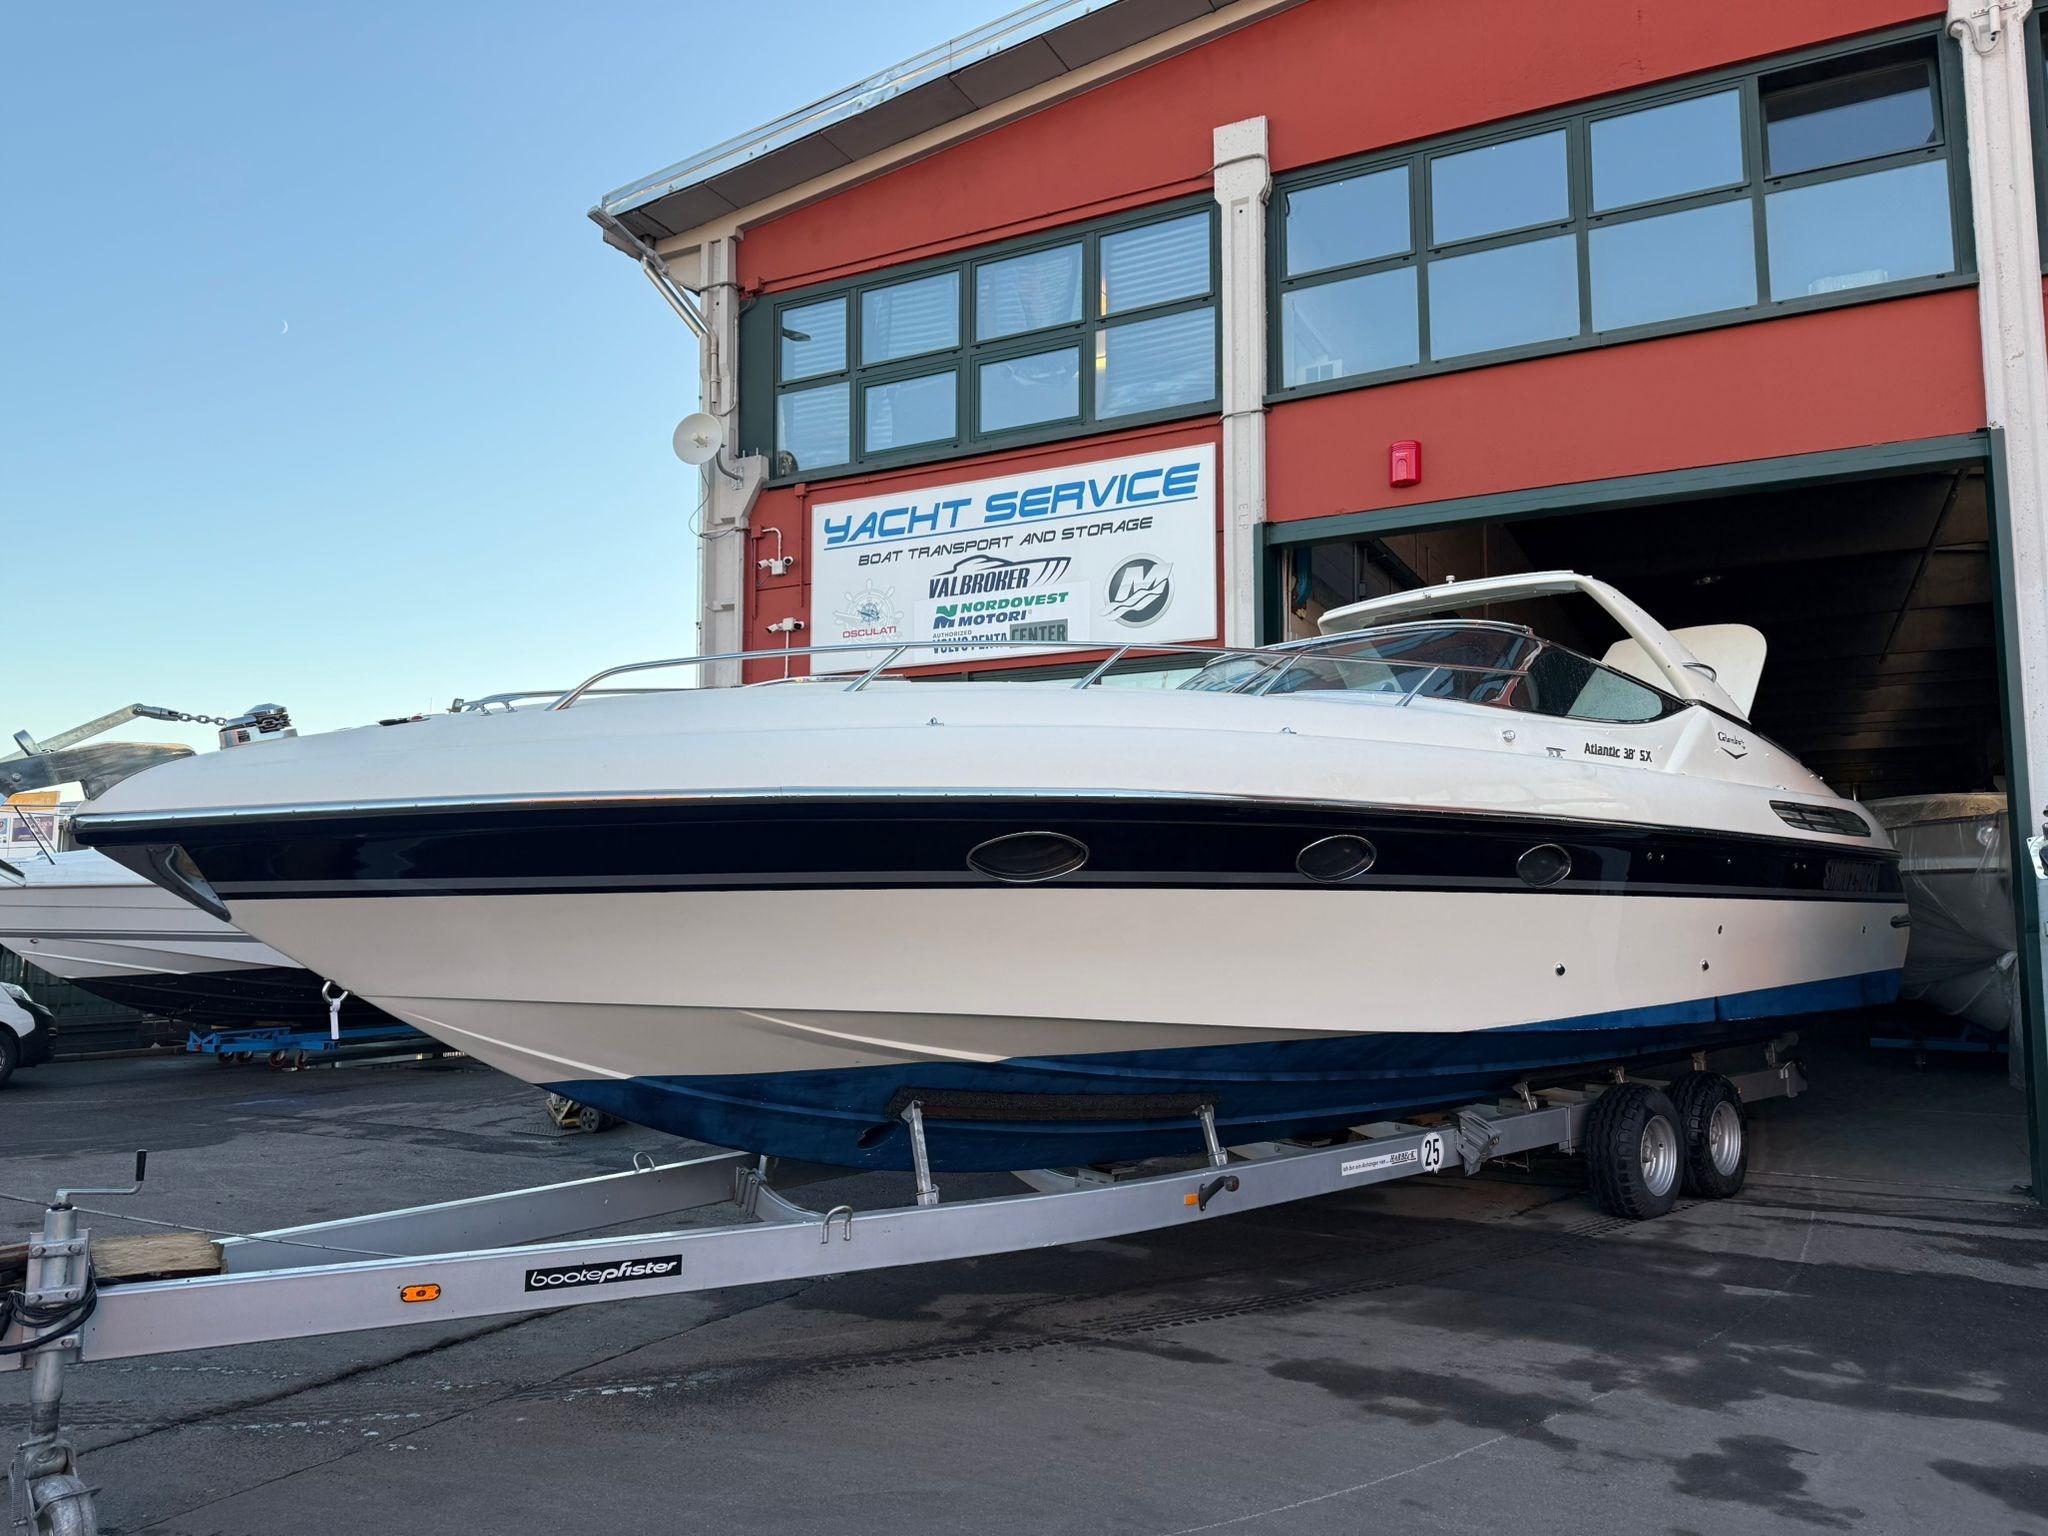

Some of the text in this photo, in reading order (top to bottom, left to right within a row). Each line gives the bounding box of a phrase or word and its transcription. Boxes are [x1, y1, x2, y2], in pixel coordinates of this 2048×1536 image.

[824, 463, 1200, 545] YACHT SERVICE
[858, 516, 1153, 566] BOAT TRANSPORT AND STORAGE
[929, 567, 1030, 599] VALBROKER
[960, 592, 1068, 613] NORDOVEST
[958, 610, 1027, 627] MOTORI
[843, 625, 897, 638] OSCULATI
[933, 629, 972, 638] AUTHORIZED
[1011, 623, 1066, 643] CENTER
[1584, 742, 1620, 758] Atlantic
[1425, 1139, 1440, 1167] 25
[530, 1261, 678, 1288] bootepfister
